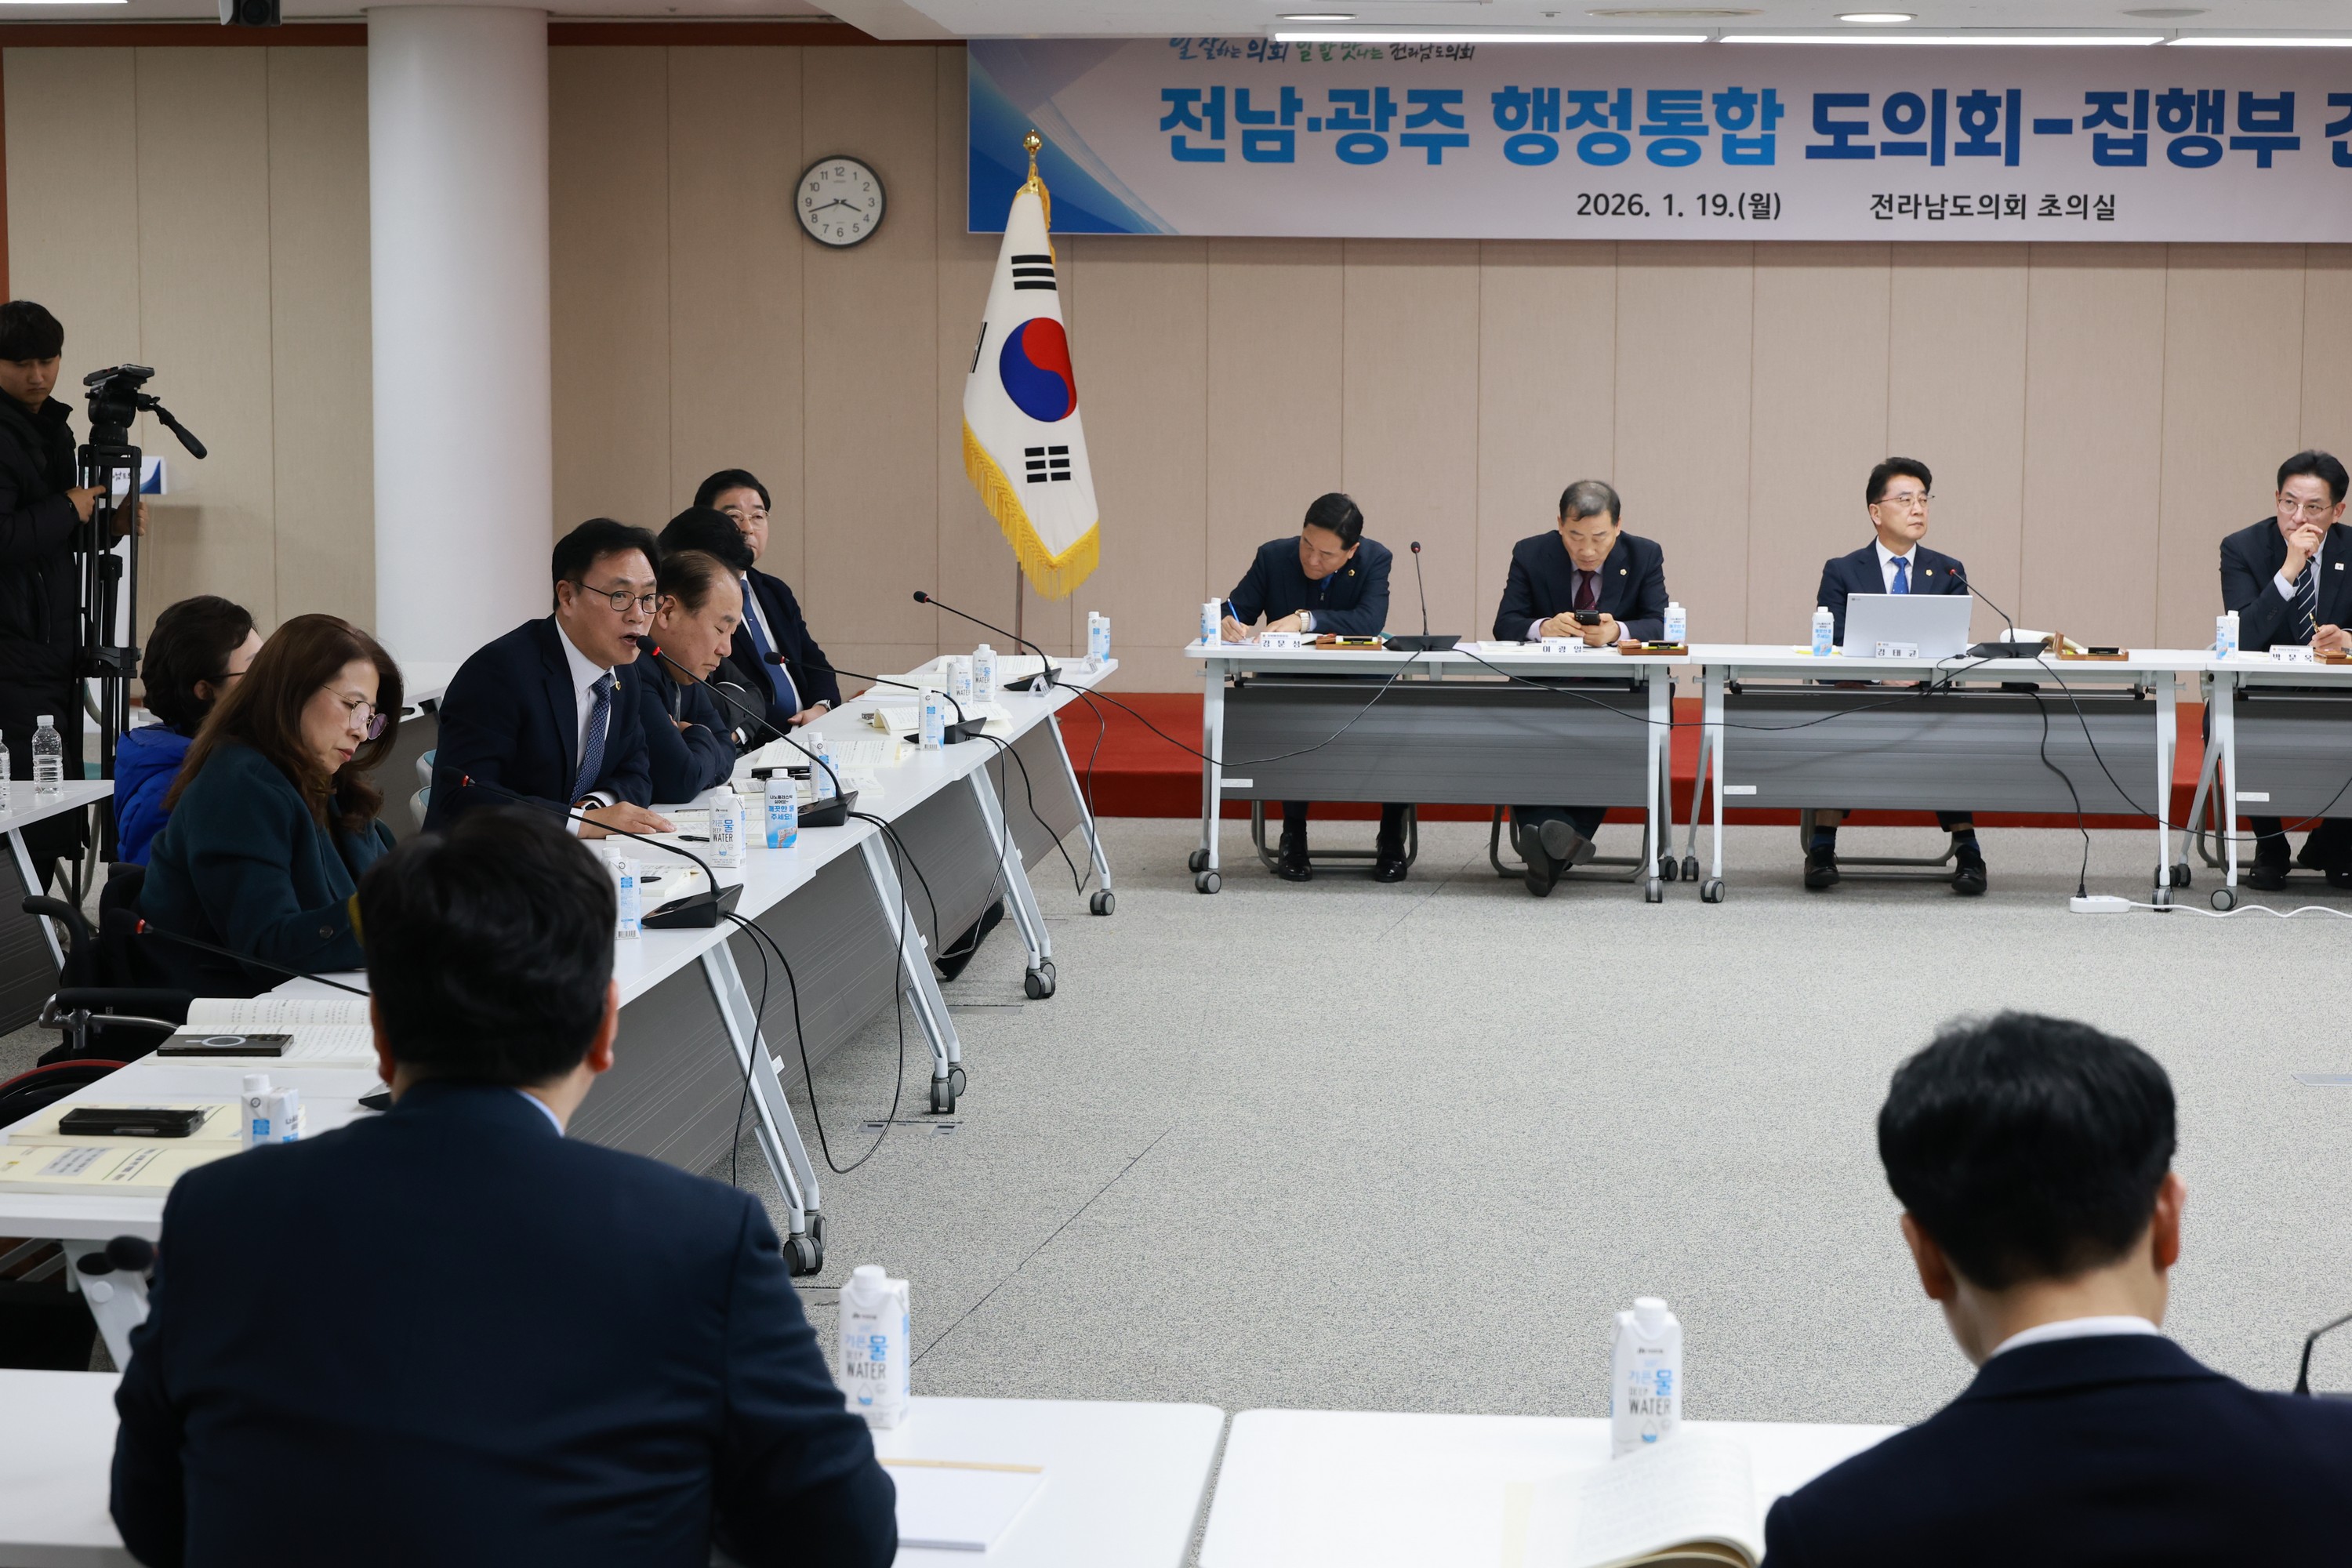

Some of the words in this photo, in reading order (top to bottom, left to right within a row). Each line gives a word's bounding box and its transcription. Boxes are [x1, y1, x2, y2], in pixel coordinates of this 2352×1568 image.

[1247, 38, 1290, 63] 의회
[1389, 42, 1475, 62] 전라남도의회
[1491, 85, 1784, 168] 행정통합
[1805, 86, 2301, 169] 도의회-집행부
[820, 171, 828, 180] 11
[834, 166, 845, 176] 12
[853, 172, 857, 180] 1
[809, 182, 820, 192] 10
[863, 182, 870, 192] 2
[805, 198, 812, 207] 9
[868, 198, 875, 207] 3
[1576, 193, 1651, 217] 2026.
[1663, 194, 1683, 217] 1.
[1697, 192, 1780, 220] 19.(월)
[1870, 193, 2027, 220] 전라남도의회
[2037, 193, 2116, 221] 초의실
[811, 213, 818, 223] 8
[863, 213, 870, 223] 4
[822, 223, 829, 234] 7
[837, 227, 844, 238] 6
[852, 223, 860, 233] 5
[723, 818, 734, 833] 물
[713, 833, 733, 843] WATER
[868, 1335, 888, 1362] 물
[846, 1362, 887, 1380] WATER
[1653, 1370, 1672, 1397] 물
[1628, 1398, 1671, 1417] WATER
